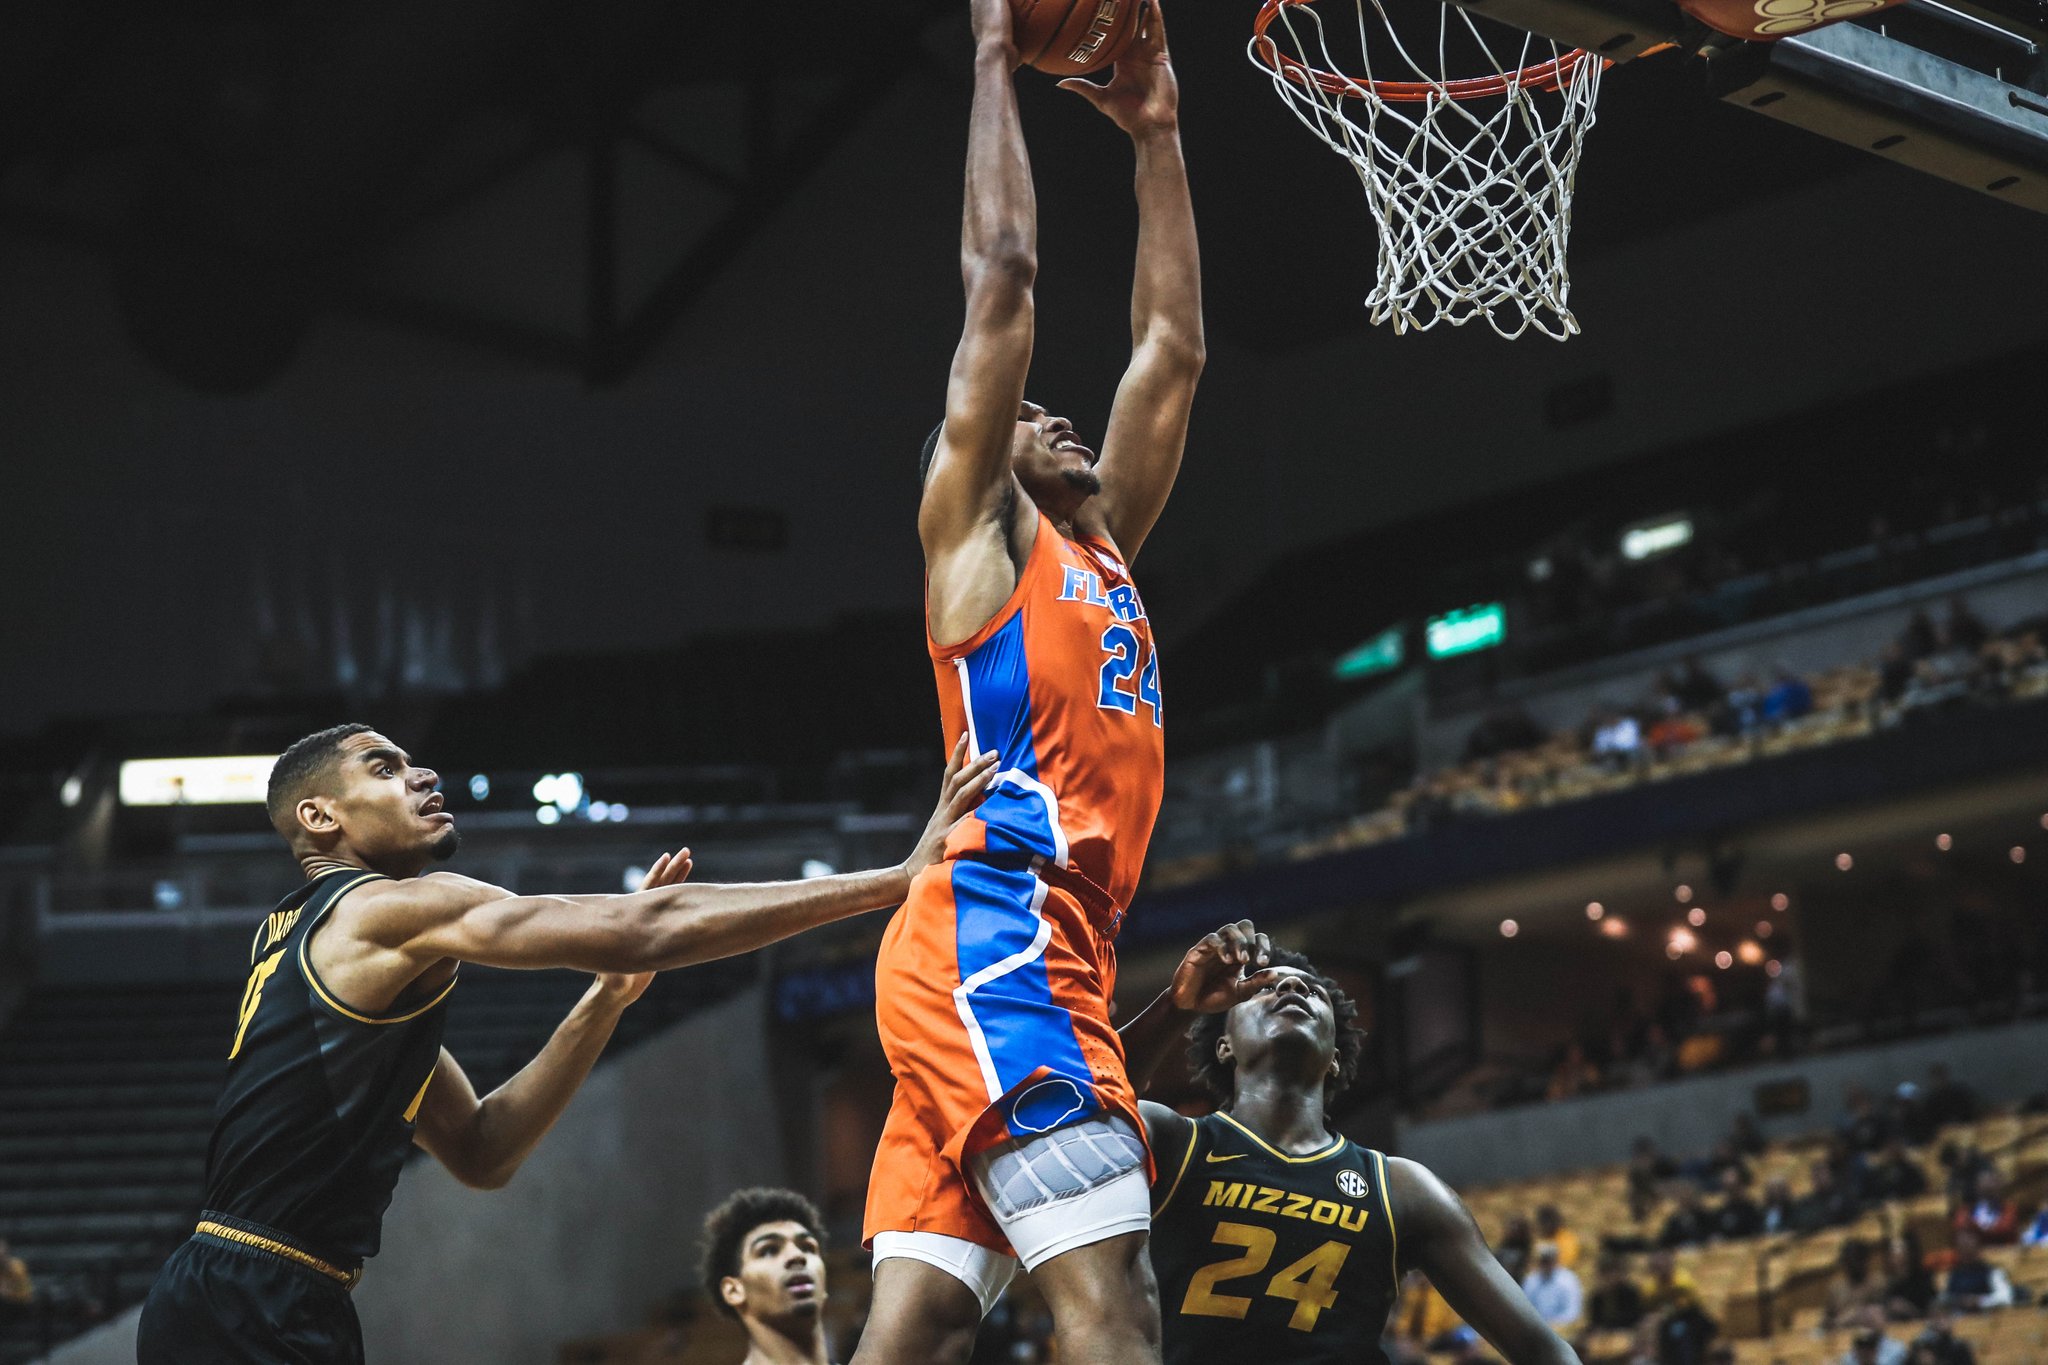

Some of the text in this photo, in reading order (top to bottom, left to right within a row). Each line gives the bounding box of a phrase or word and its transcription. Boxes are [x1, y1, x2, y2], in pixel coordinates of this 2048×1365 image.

[1096, 623, 1163, 729] 24
[1202, 1180, 1369, 1233] MIZZOU
[1339, 1171, 1366, 1196] SEC
[1180, 1221, 1352, 1333] 24
